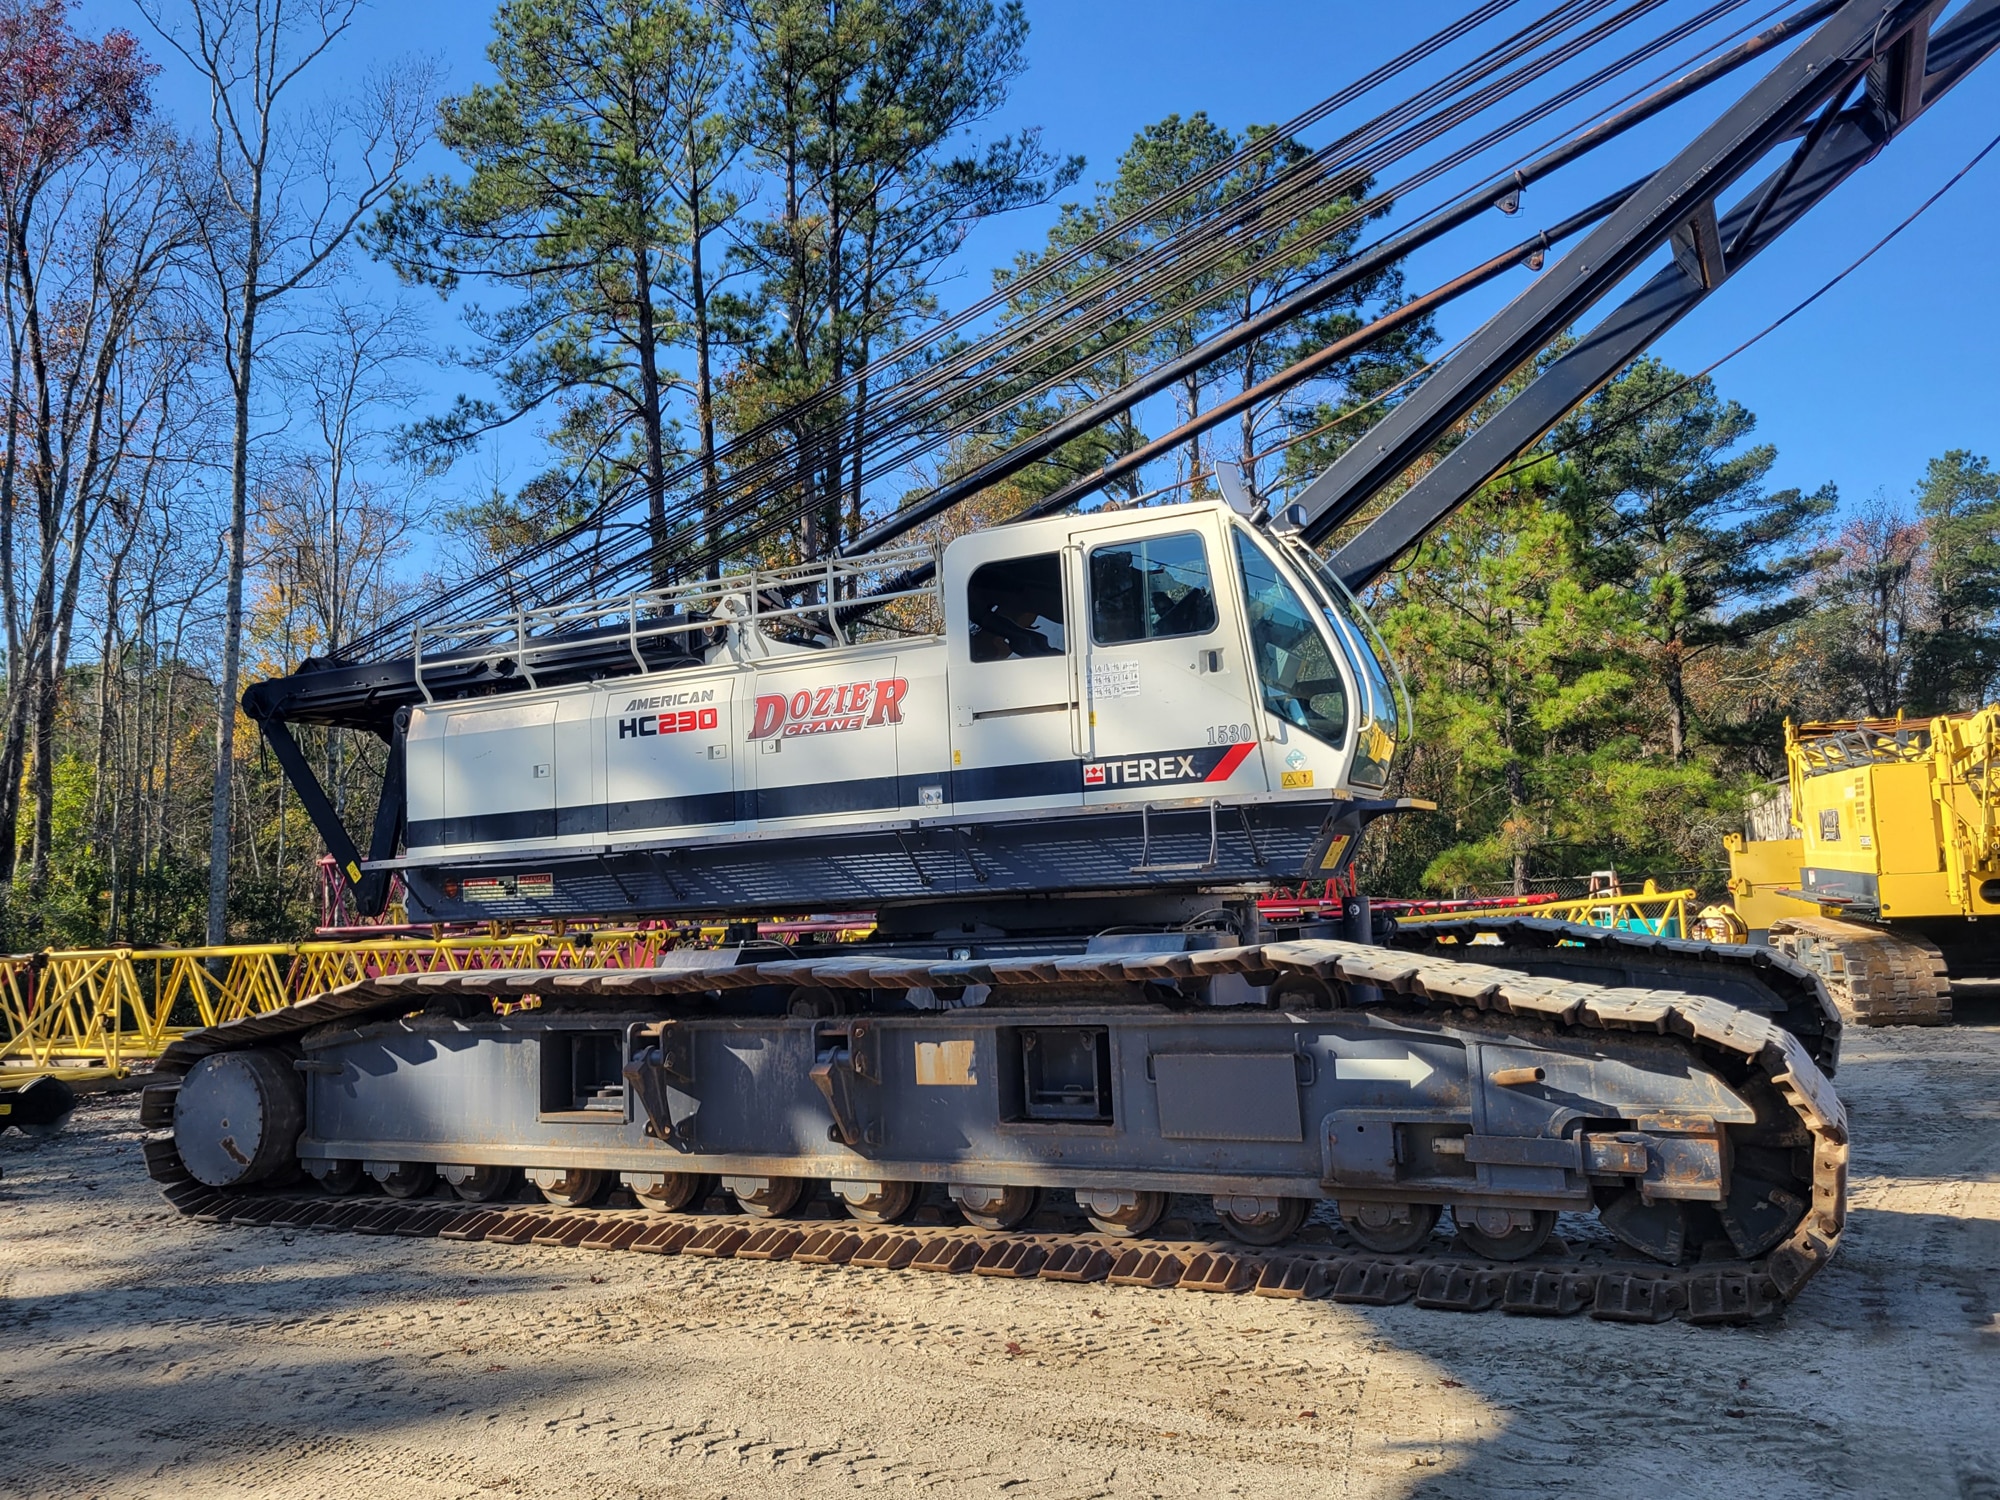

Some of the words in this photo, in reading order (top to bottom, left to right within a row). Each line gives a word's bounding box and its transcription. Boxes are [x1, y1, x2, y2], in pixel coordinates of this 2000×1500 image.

[625, 689, 714, 712] AMERICAN
[747, 678, 908, 741] DOZIER
[619, 708, 717, 739] HC230
[785, 718, 858, 735] CRANE
[1206, 723, 1251, 745] 1530
[1106, 755, 1196, 783] TEREX
